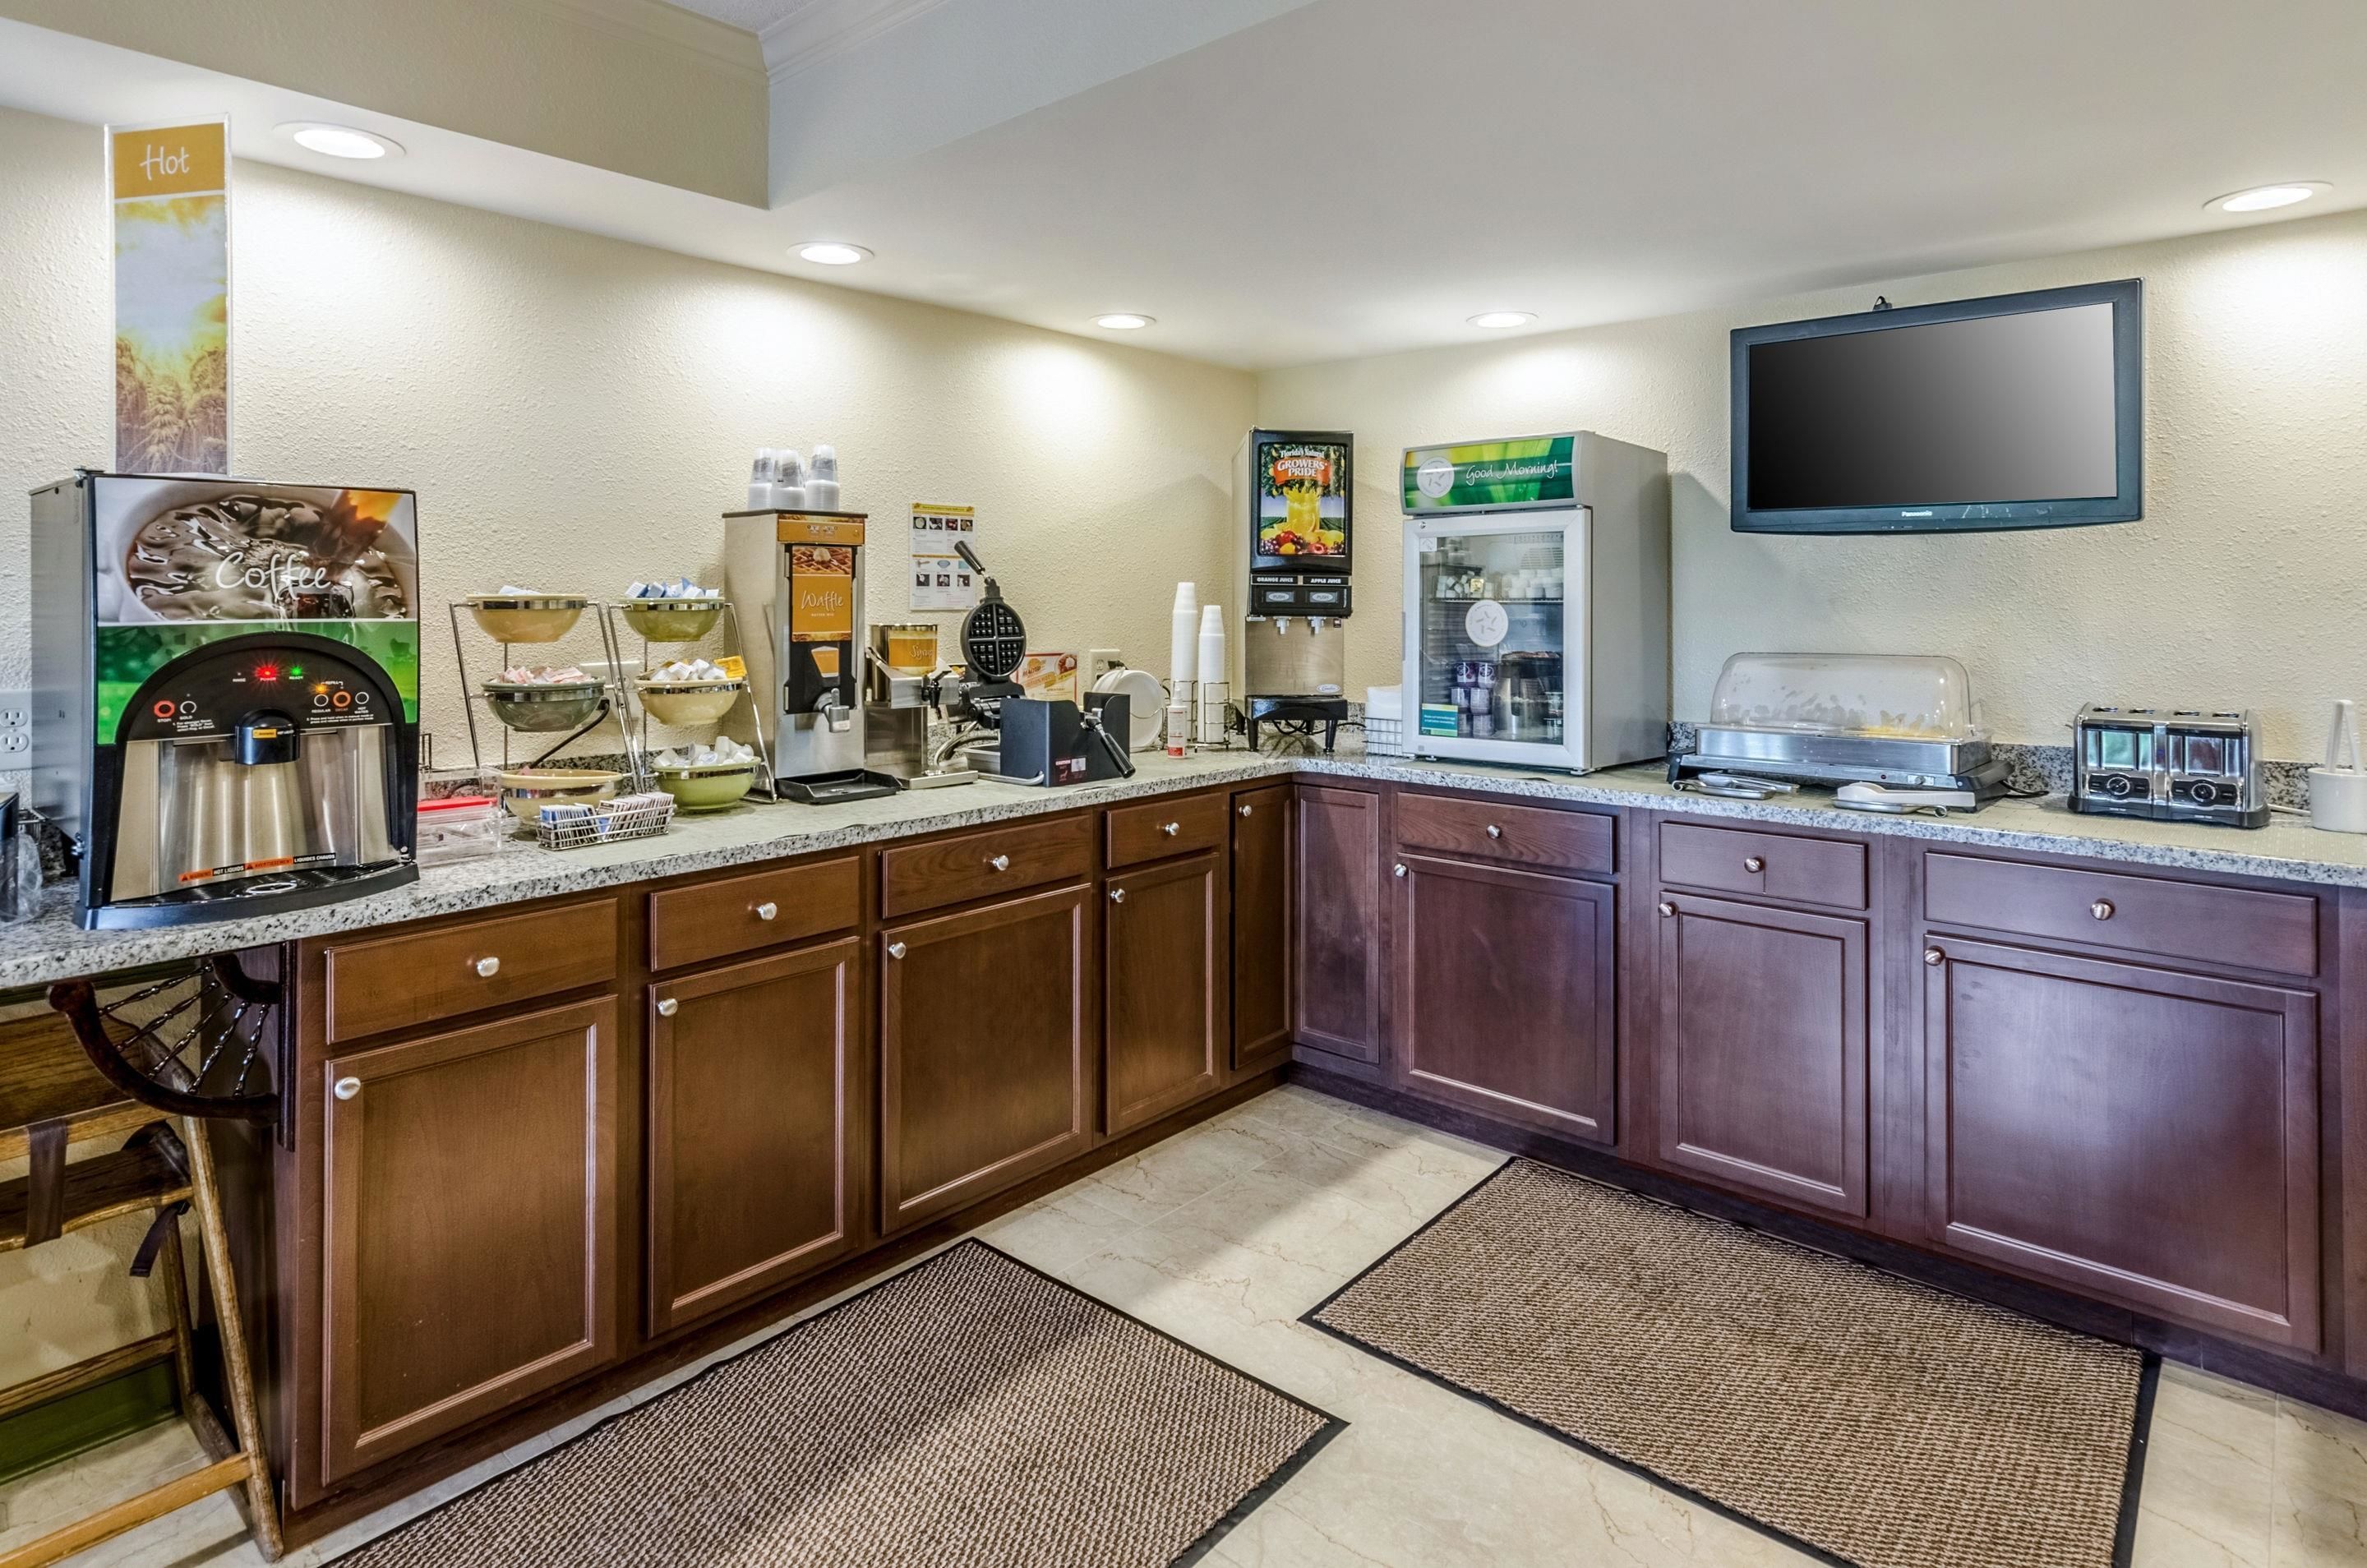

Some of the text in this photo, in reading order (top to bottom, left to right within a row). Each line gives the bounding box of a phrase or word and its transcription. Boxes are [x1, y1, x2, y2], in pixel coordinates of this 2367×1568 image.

[139, 144, 190, 181] Hot
[1288, 467, 1317, 477] PRIDE
[1465, 459, 1558, 487] Good Morning!
[215, 551, 330, 602] Coffee
[801, 590, 844, 611] Waffle
